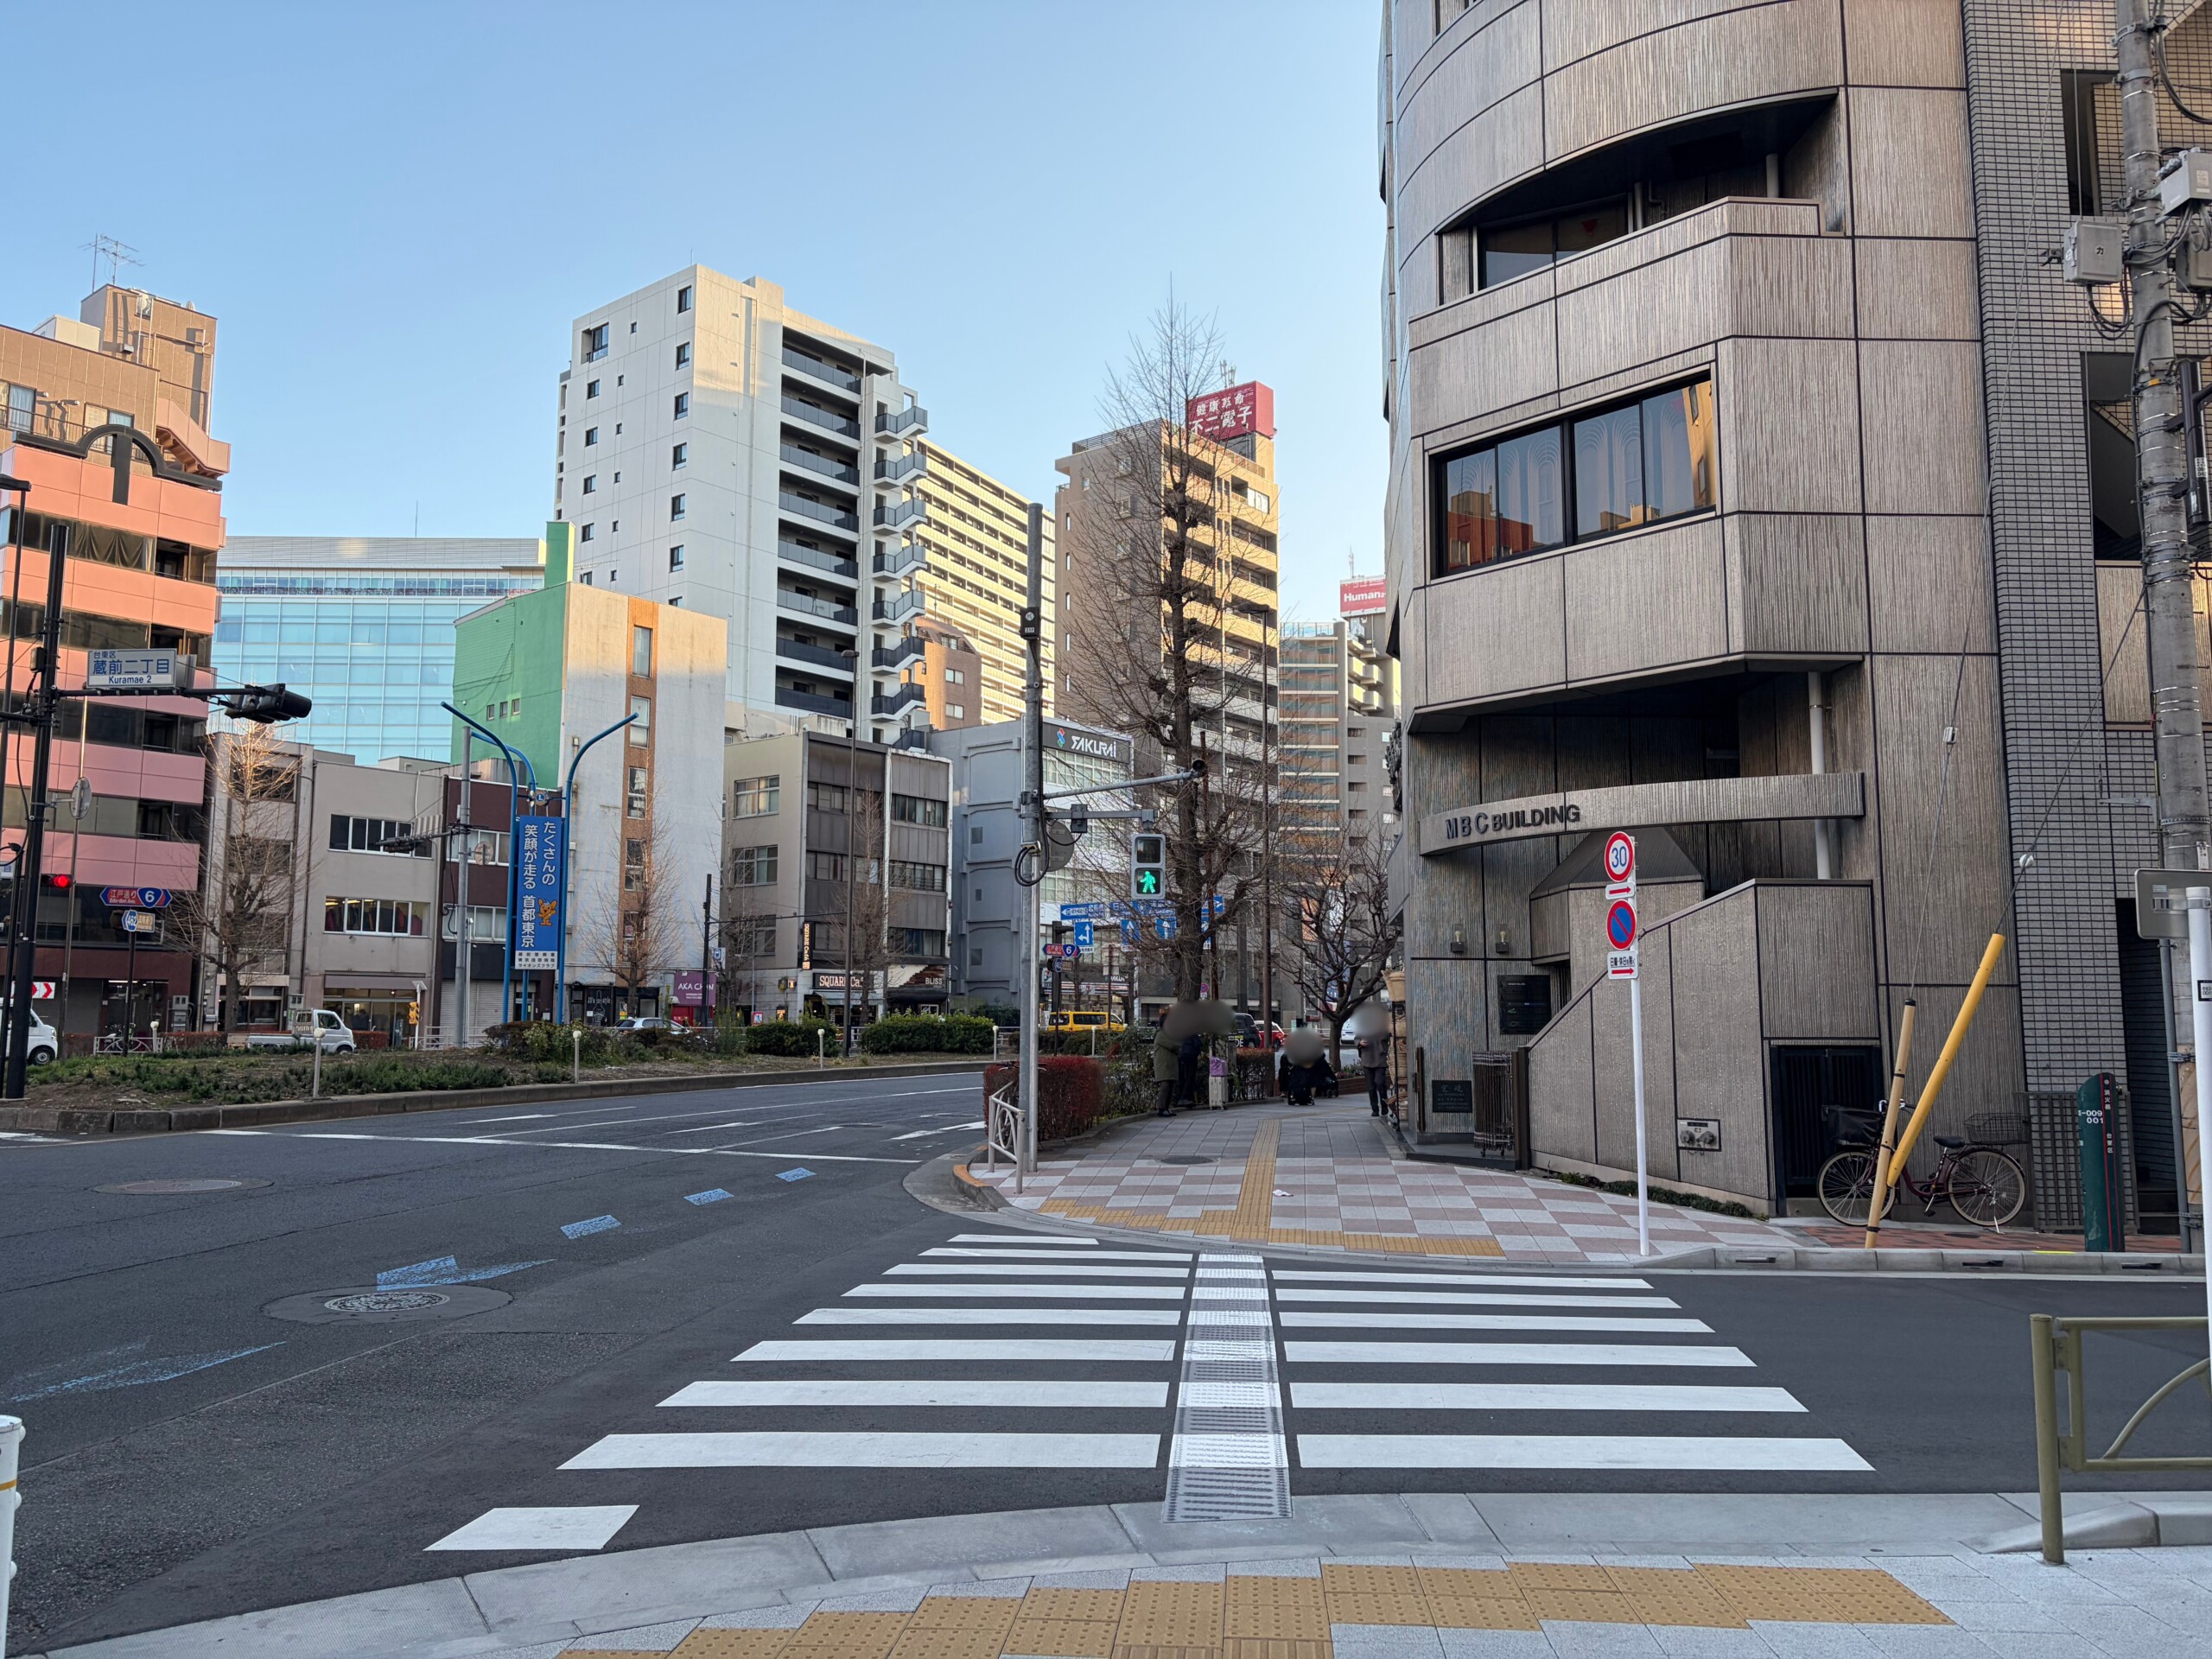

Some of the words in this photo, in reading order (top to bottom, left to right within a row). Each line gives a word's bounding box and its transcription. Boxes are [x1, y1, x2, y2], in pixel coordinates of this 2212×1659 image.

[92, 658, 170, 675] 蔵前二丁目
[93, 651, 117, 659] 台東区
[108, 676, 144, 684] Kuramae
[146, 675, 152, 683] 2
[1071, 735, 1116, 758] SAKURAI
[1446, 811, 1489, 841] MBC
[1491, 804, 1580, 832] BUILDING
[523, 824, 538, 890] 笑顔が走る
[542, 821, 556, 886] たくさんの
[1611, 845, 1628, 868] 30
[110, 889, 137, 899] 江戸通り
[144, 890, 156, 903] 6
[521, 895, 537, 948] 首都東京
